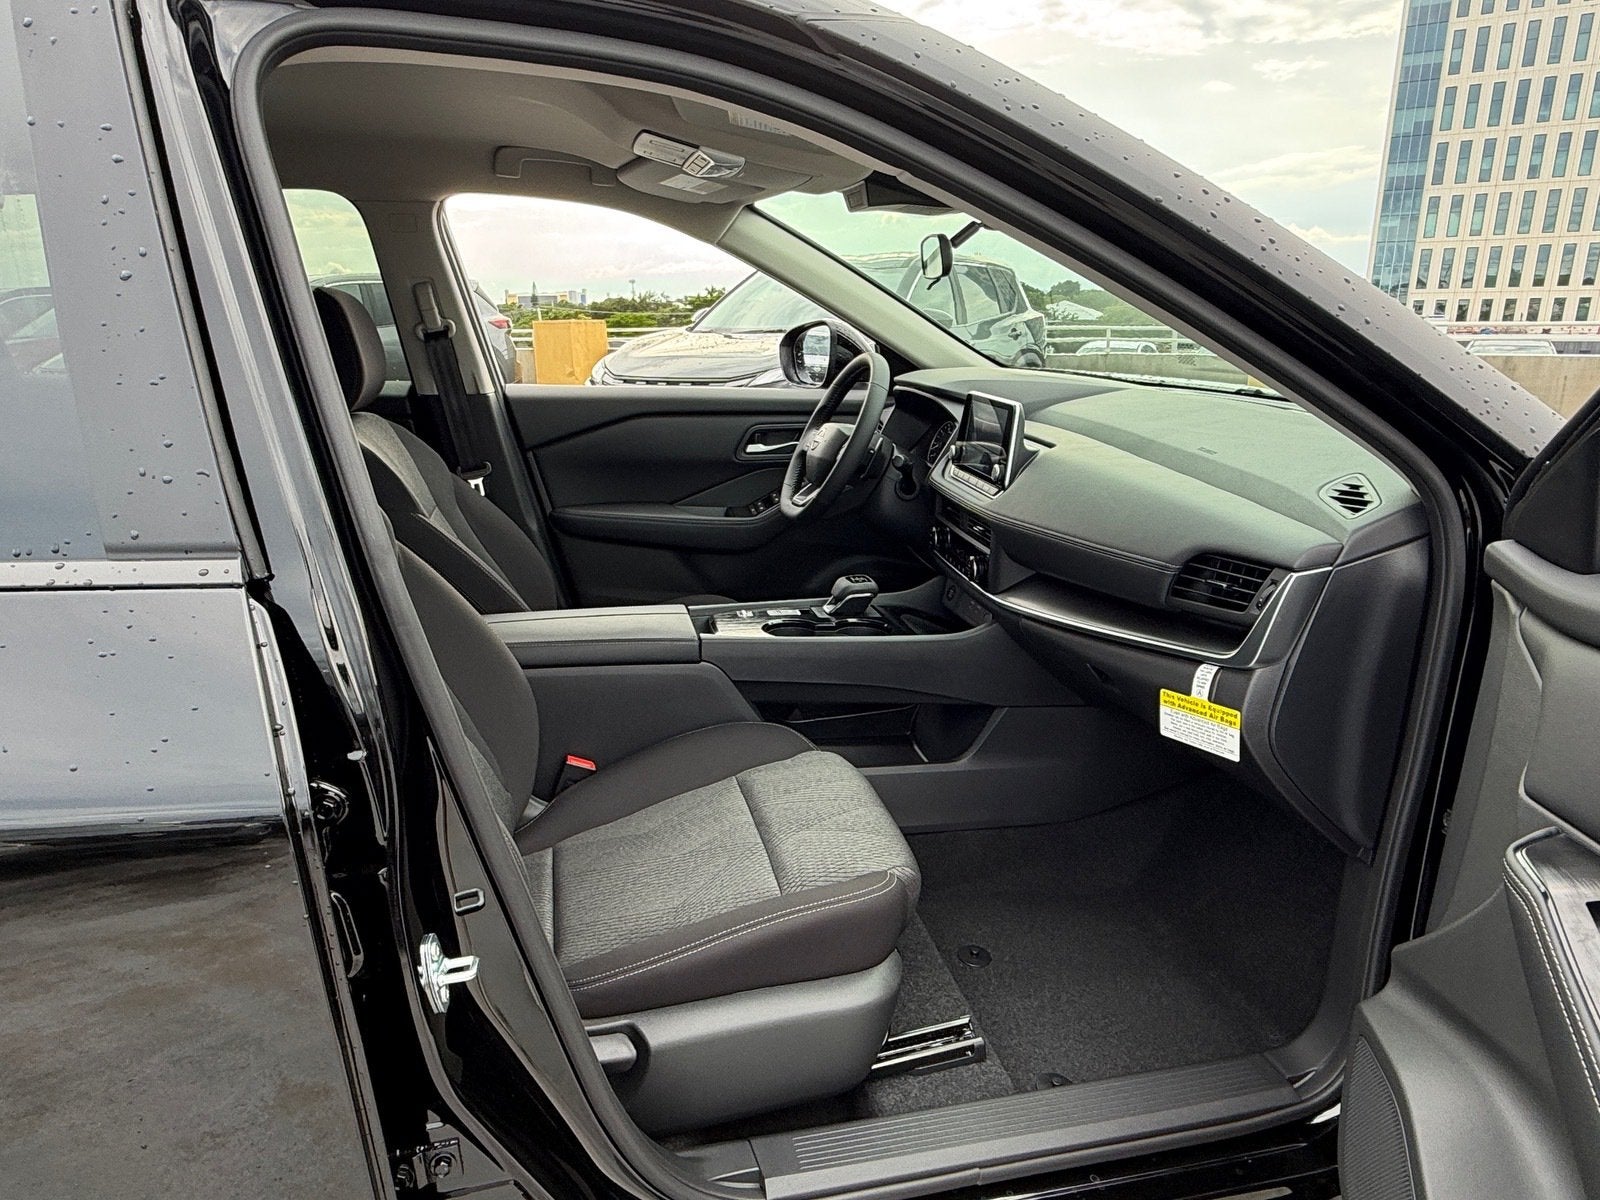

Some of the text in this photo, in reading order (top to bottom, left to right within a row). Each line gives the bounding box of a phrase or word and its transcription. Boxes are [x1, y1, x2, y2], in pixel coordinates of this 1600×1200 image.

[1162, 691, 1175, 700] This
[1177, 695, 1199, 707] Vehicle
[1208, 705, 1238, 719] Equipped
[1163, 699, 1237, 727] with Advanced Air Bags
